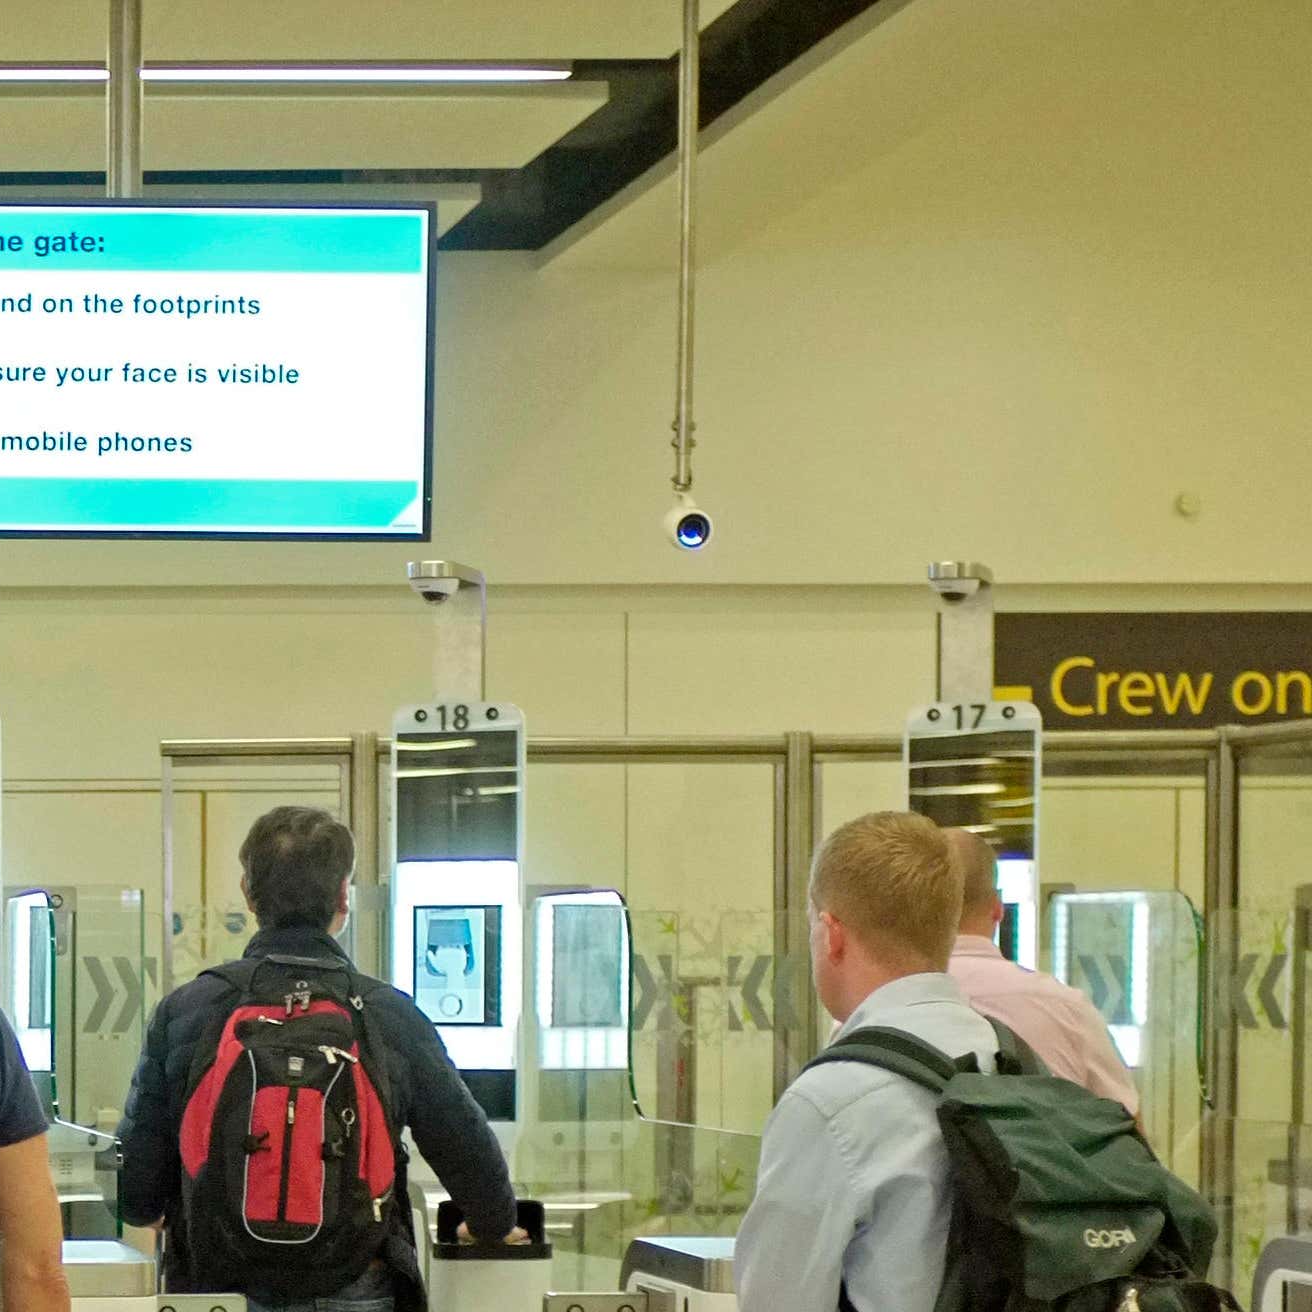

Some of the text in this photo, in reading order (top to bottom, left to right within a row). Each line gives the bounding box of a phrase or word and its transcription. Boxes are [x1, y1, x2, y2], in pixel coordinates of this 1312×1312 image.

[34, 232, 105, 257] gate:
[43, 298, 73, 314] on
[83, 294, 123, 314] the
[133, 293, 260, 319] footprints
[55, 367, 113, 387] your
[122, 363, 177, 383] face
[188, 363, 207, 383] is
[217, 363, 299, 384] visible
[1, 432, 88, 452] mobile
[98, 432, 192, 456] phones
[1050, 656, 1214, 716] Crew
[436, 704, 469, 731] 18
[953, 704, 986, 730] 17
